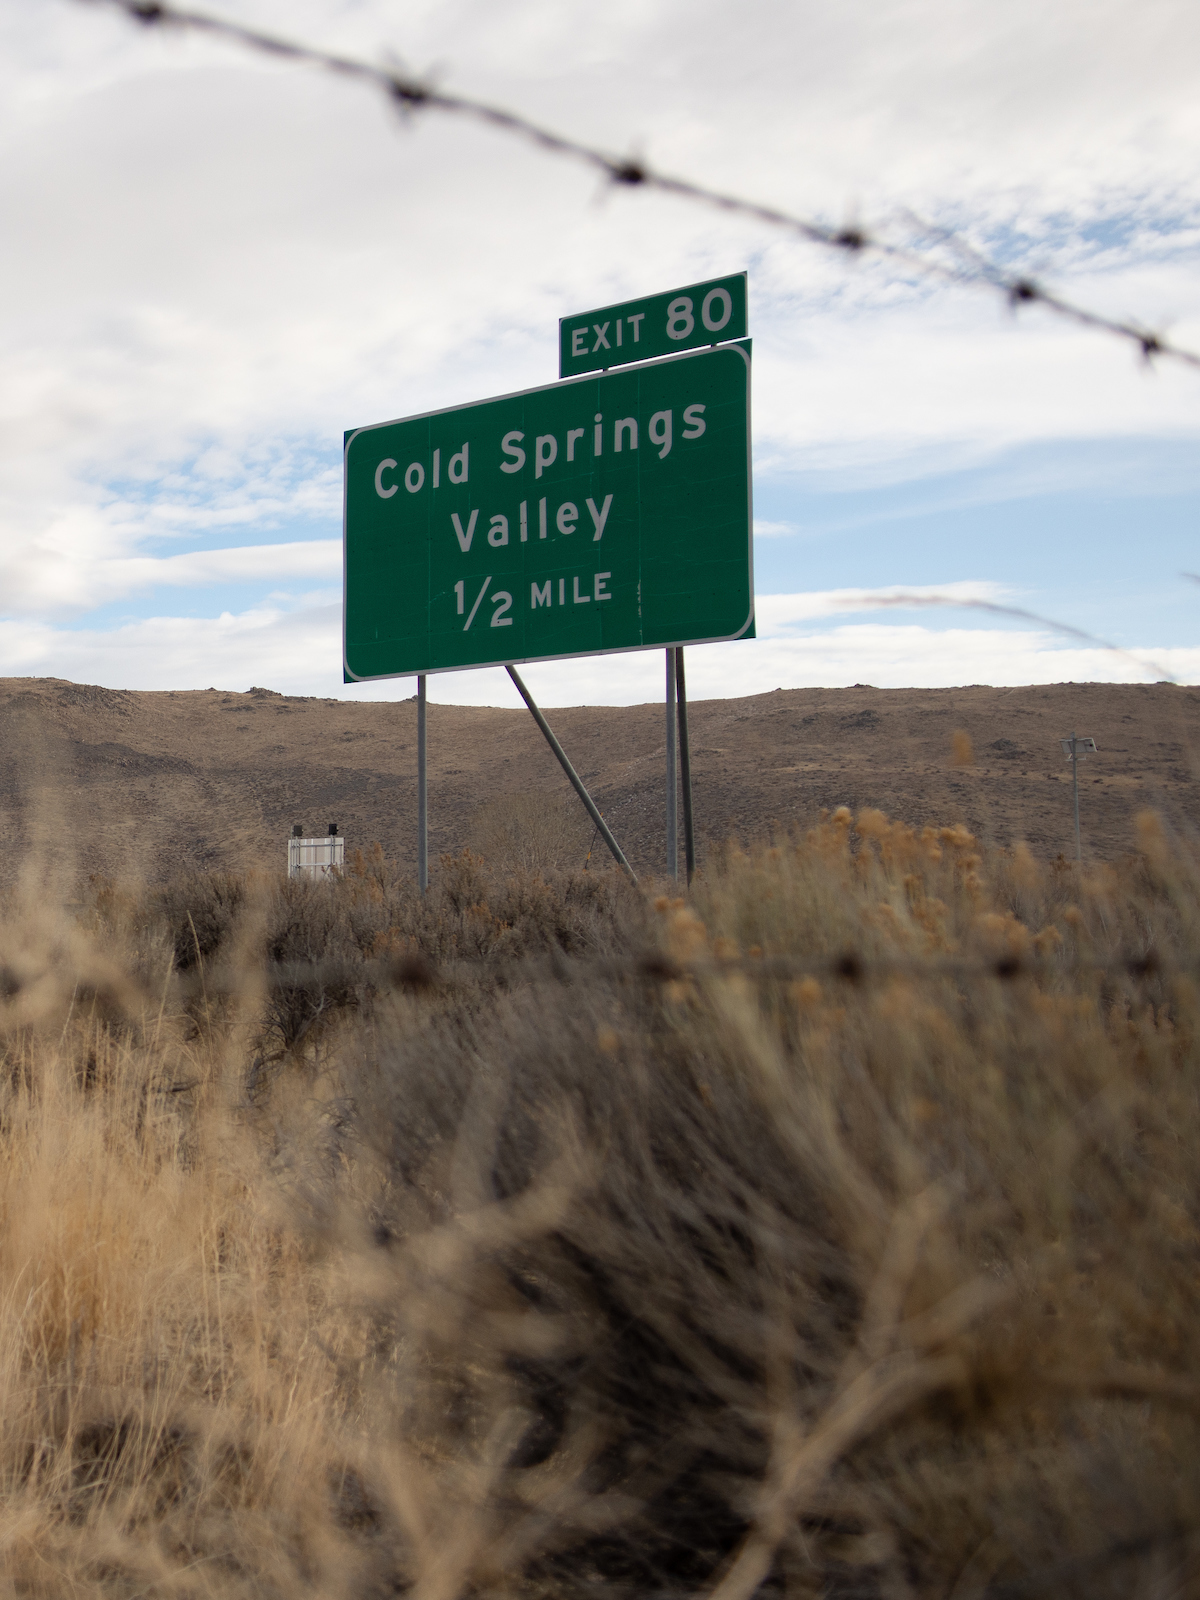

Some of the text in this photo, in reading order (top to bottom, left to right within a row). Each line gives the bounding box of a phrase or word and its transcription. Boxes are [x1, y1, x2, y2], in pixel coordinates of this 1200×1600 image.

[571, 287, 732, 357] EXIT 80
[374, 403, 707, 499] Cold Springs
[450, 493, 614, 553] Valley
[453, 571, 613, 632] 1/2 MILE
